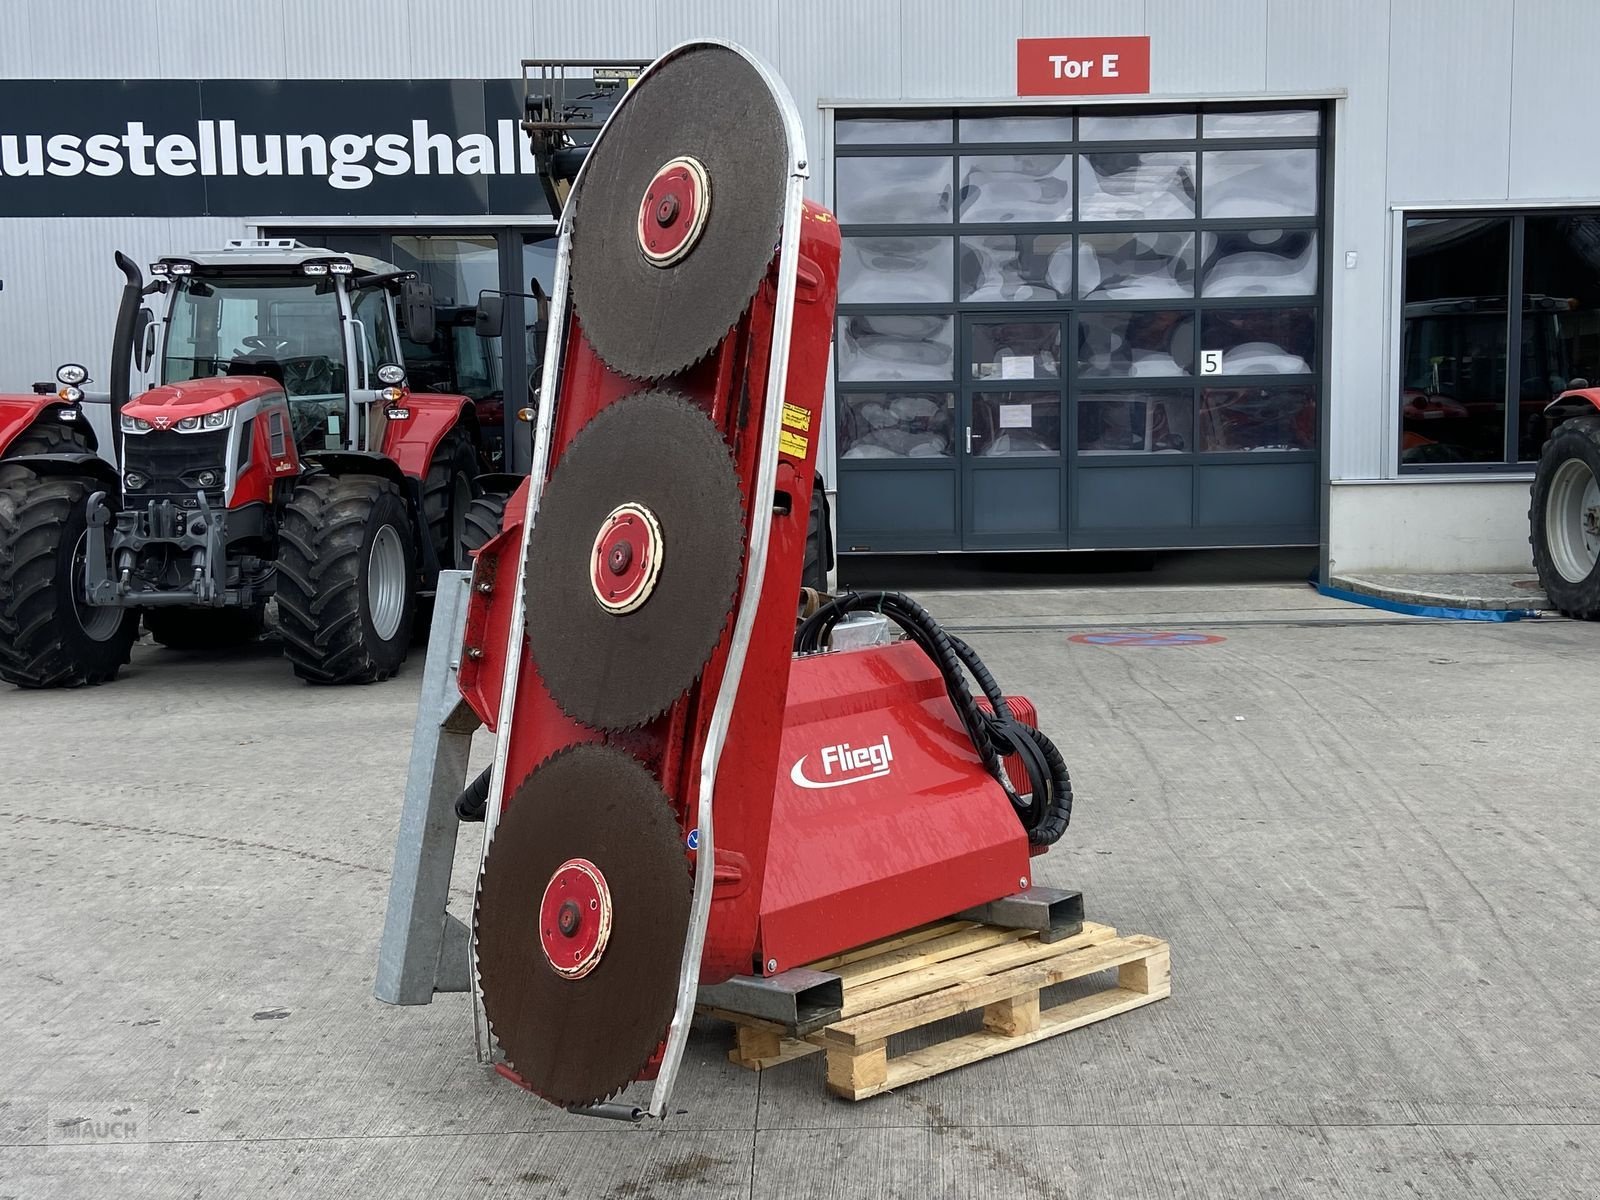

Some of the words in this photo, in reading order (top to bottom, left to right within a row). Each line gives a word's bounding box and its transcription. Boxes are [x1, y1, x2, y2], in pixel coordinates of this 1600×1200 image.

[1048, 55, 1094, 79] Tor
[1102, 54, 1119, 78] E
[0, 119, 576, 190] usstellungshall
[1205, 353, 1217, 373] 5
[821, 735, 893, 775] Fliegl
